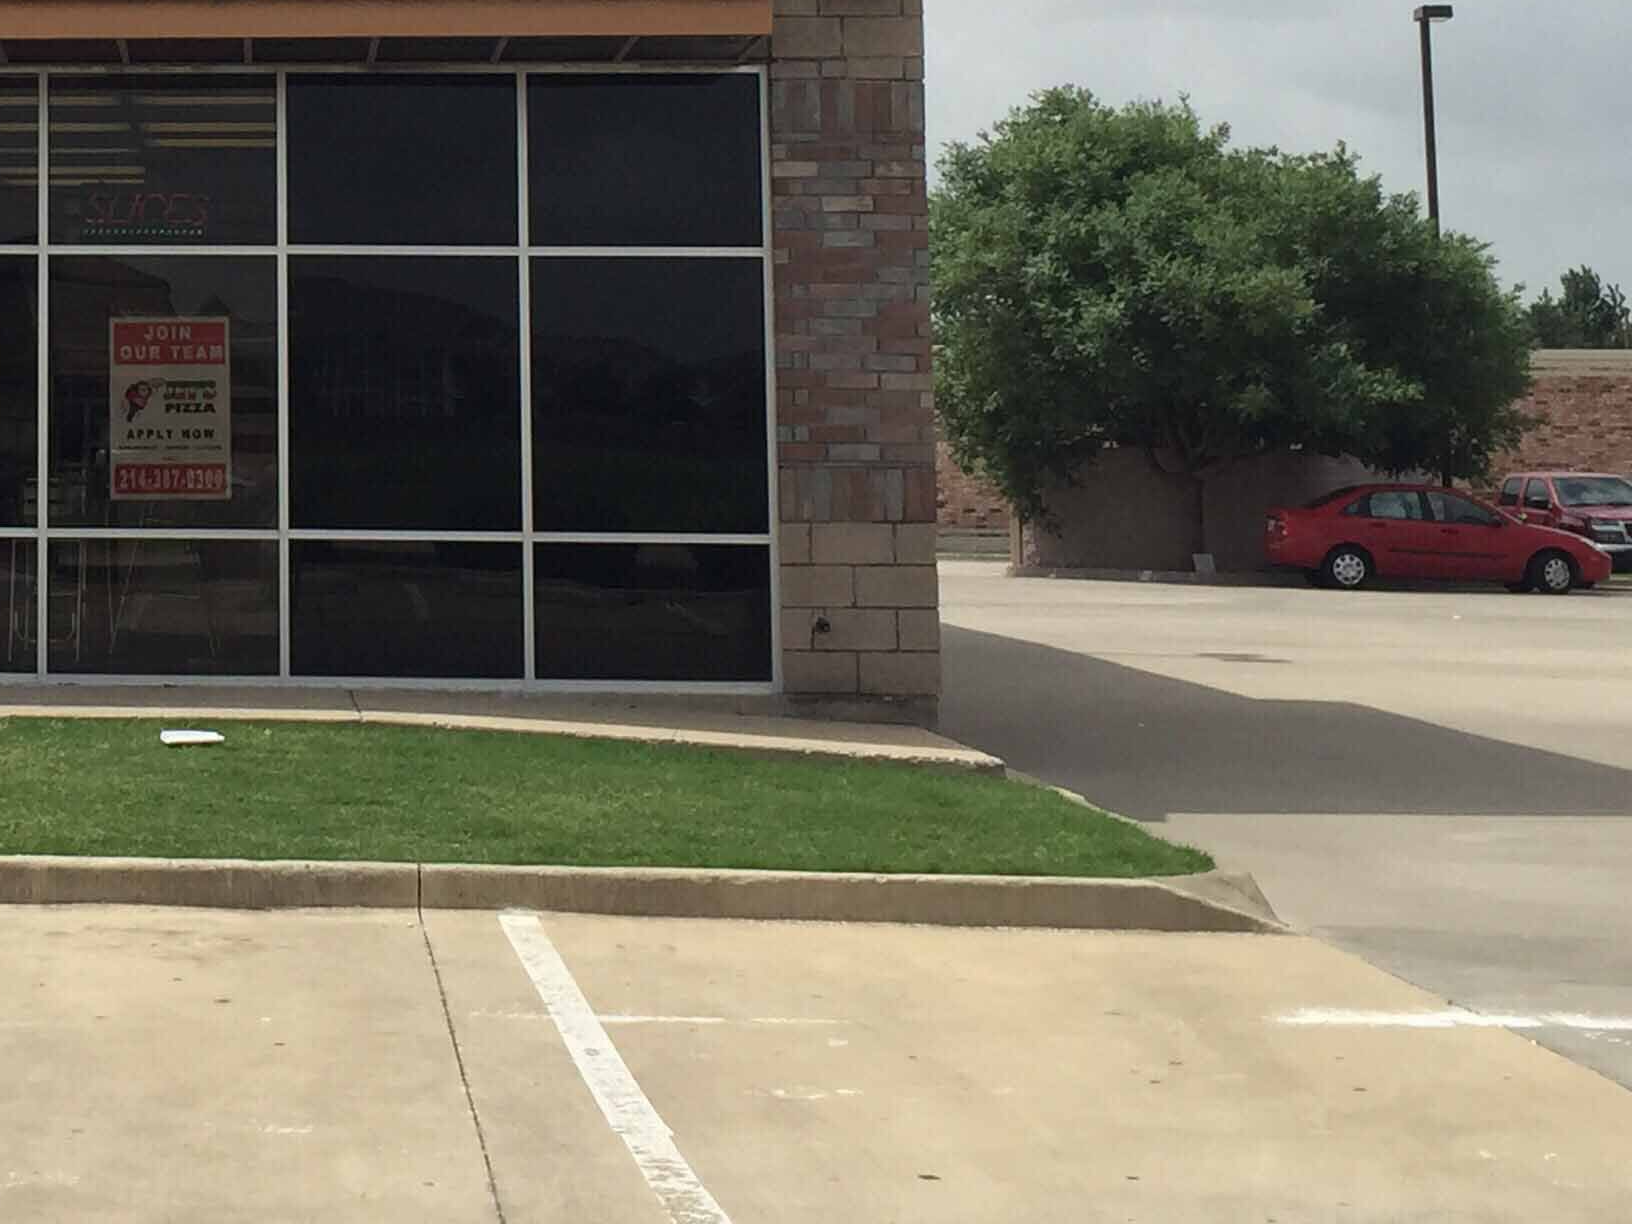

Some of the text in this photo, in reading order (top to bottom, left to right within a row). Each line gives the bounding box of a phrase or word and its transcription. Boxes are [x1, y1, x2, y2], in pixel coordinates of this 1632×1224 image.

[143, 326, 192, 341] JOIN
[119, 344, 225, 361] OUR TEAM
[164, 402, 217, 415] PIZZA
[126, 428, 216, 440] APPLY NOW
